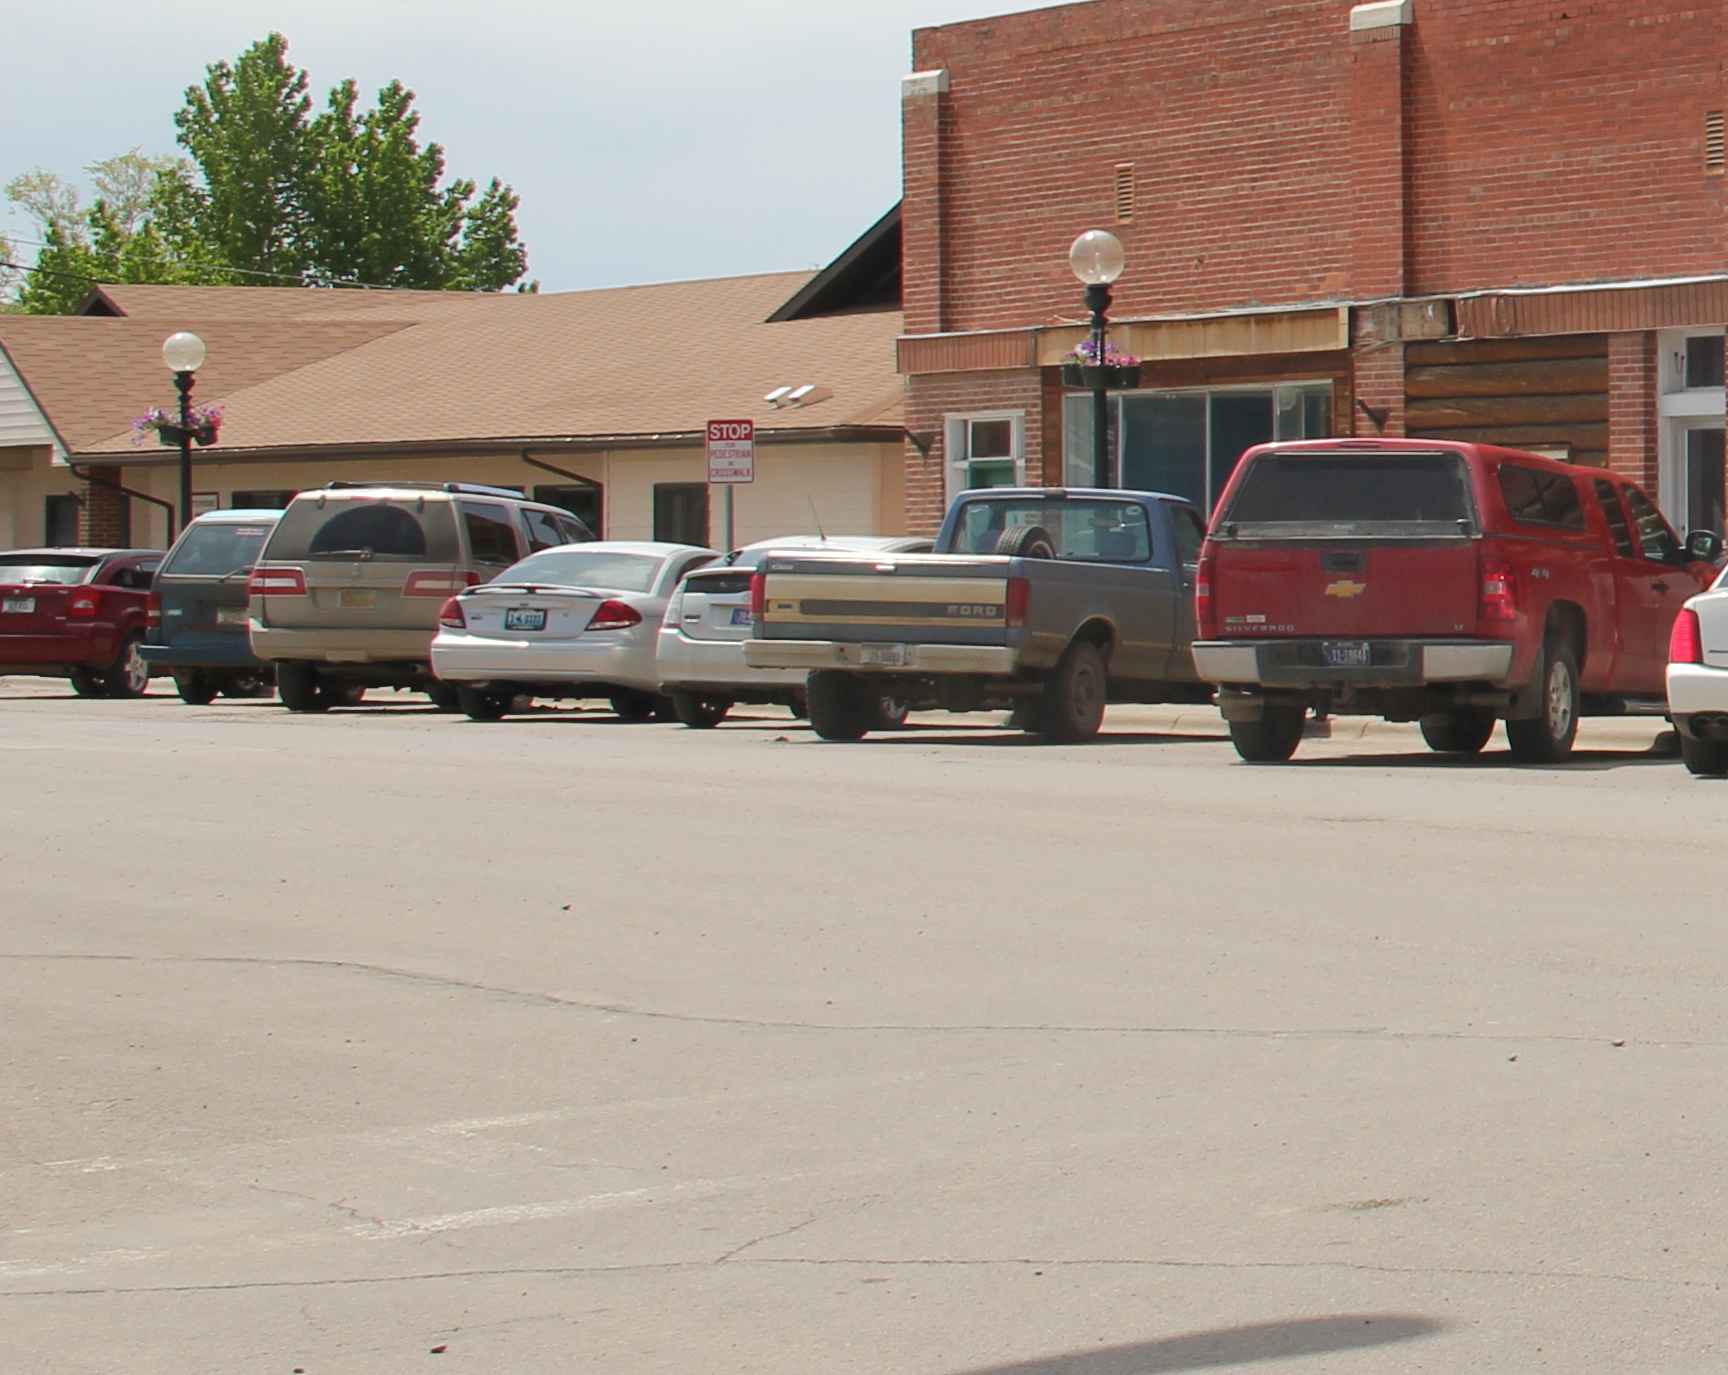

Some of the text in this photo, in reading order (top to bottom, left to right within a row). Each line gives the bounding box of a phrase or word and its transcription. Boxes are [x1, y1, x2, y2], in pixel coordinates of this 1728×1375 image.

[710, 423, 751, 439] STOP
[710, 449, 752, 459] PEDESTRIAN
[710, 468, 751, 477] CROSSWALK
[947, 605, 998, 617] FORD
